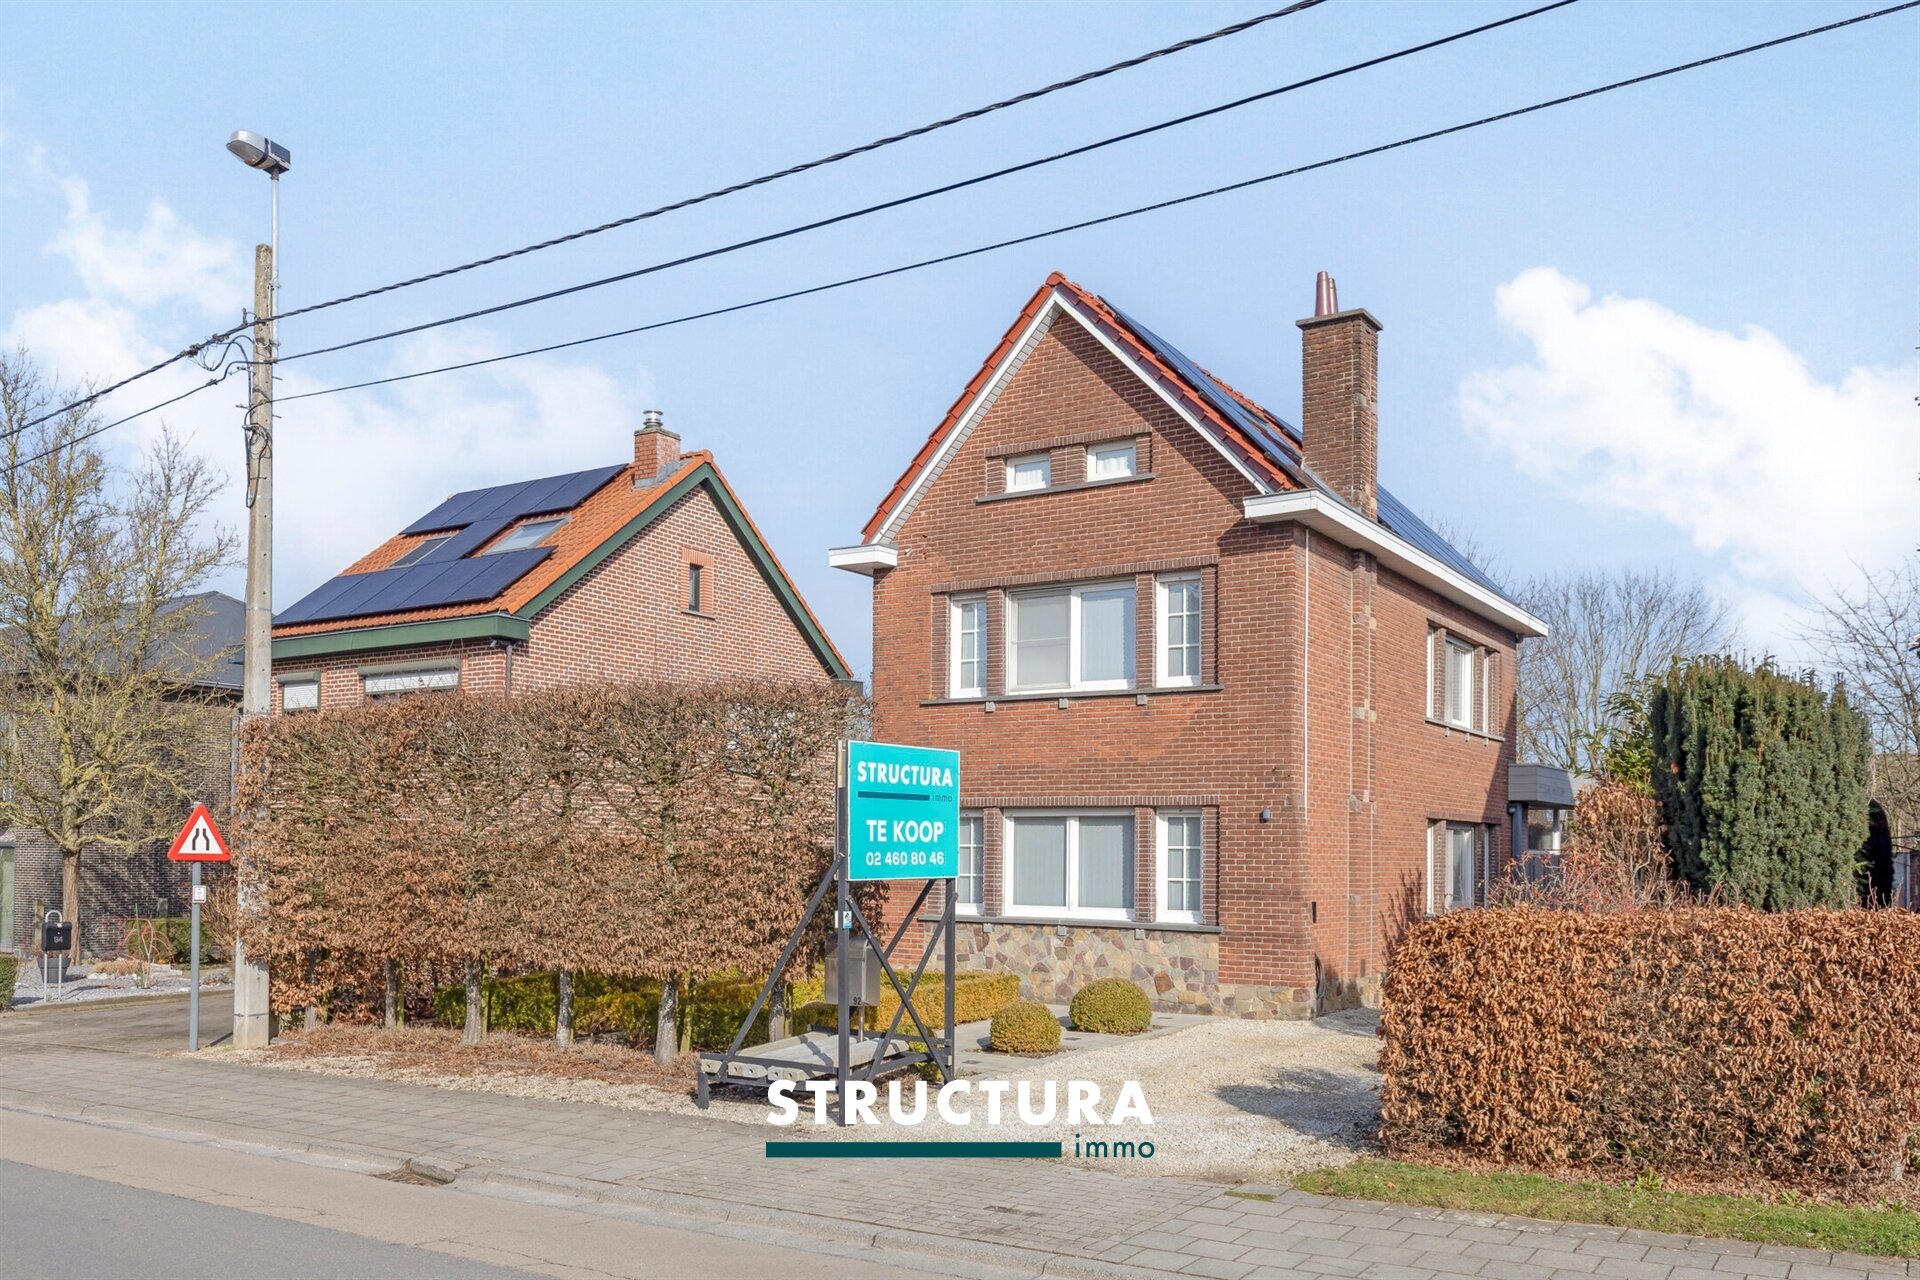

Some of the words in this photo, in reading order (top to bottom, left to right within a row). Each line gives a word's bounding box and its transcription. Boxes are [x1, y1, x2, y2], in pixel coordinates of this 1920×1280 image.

[857, 760, 953, 787] STRUCTURA
[932, 791, 953, 803] immo
[866, 820, 888, 842] TE
[893, 820, 944, 843] KOOP
[866, 852, 882, 866] 02
[884, 851, 908, 865] 460
[911, 851, 926, 865] 80
[929, 851, 945, 865] 46
